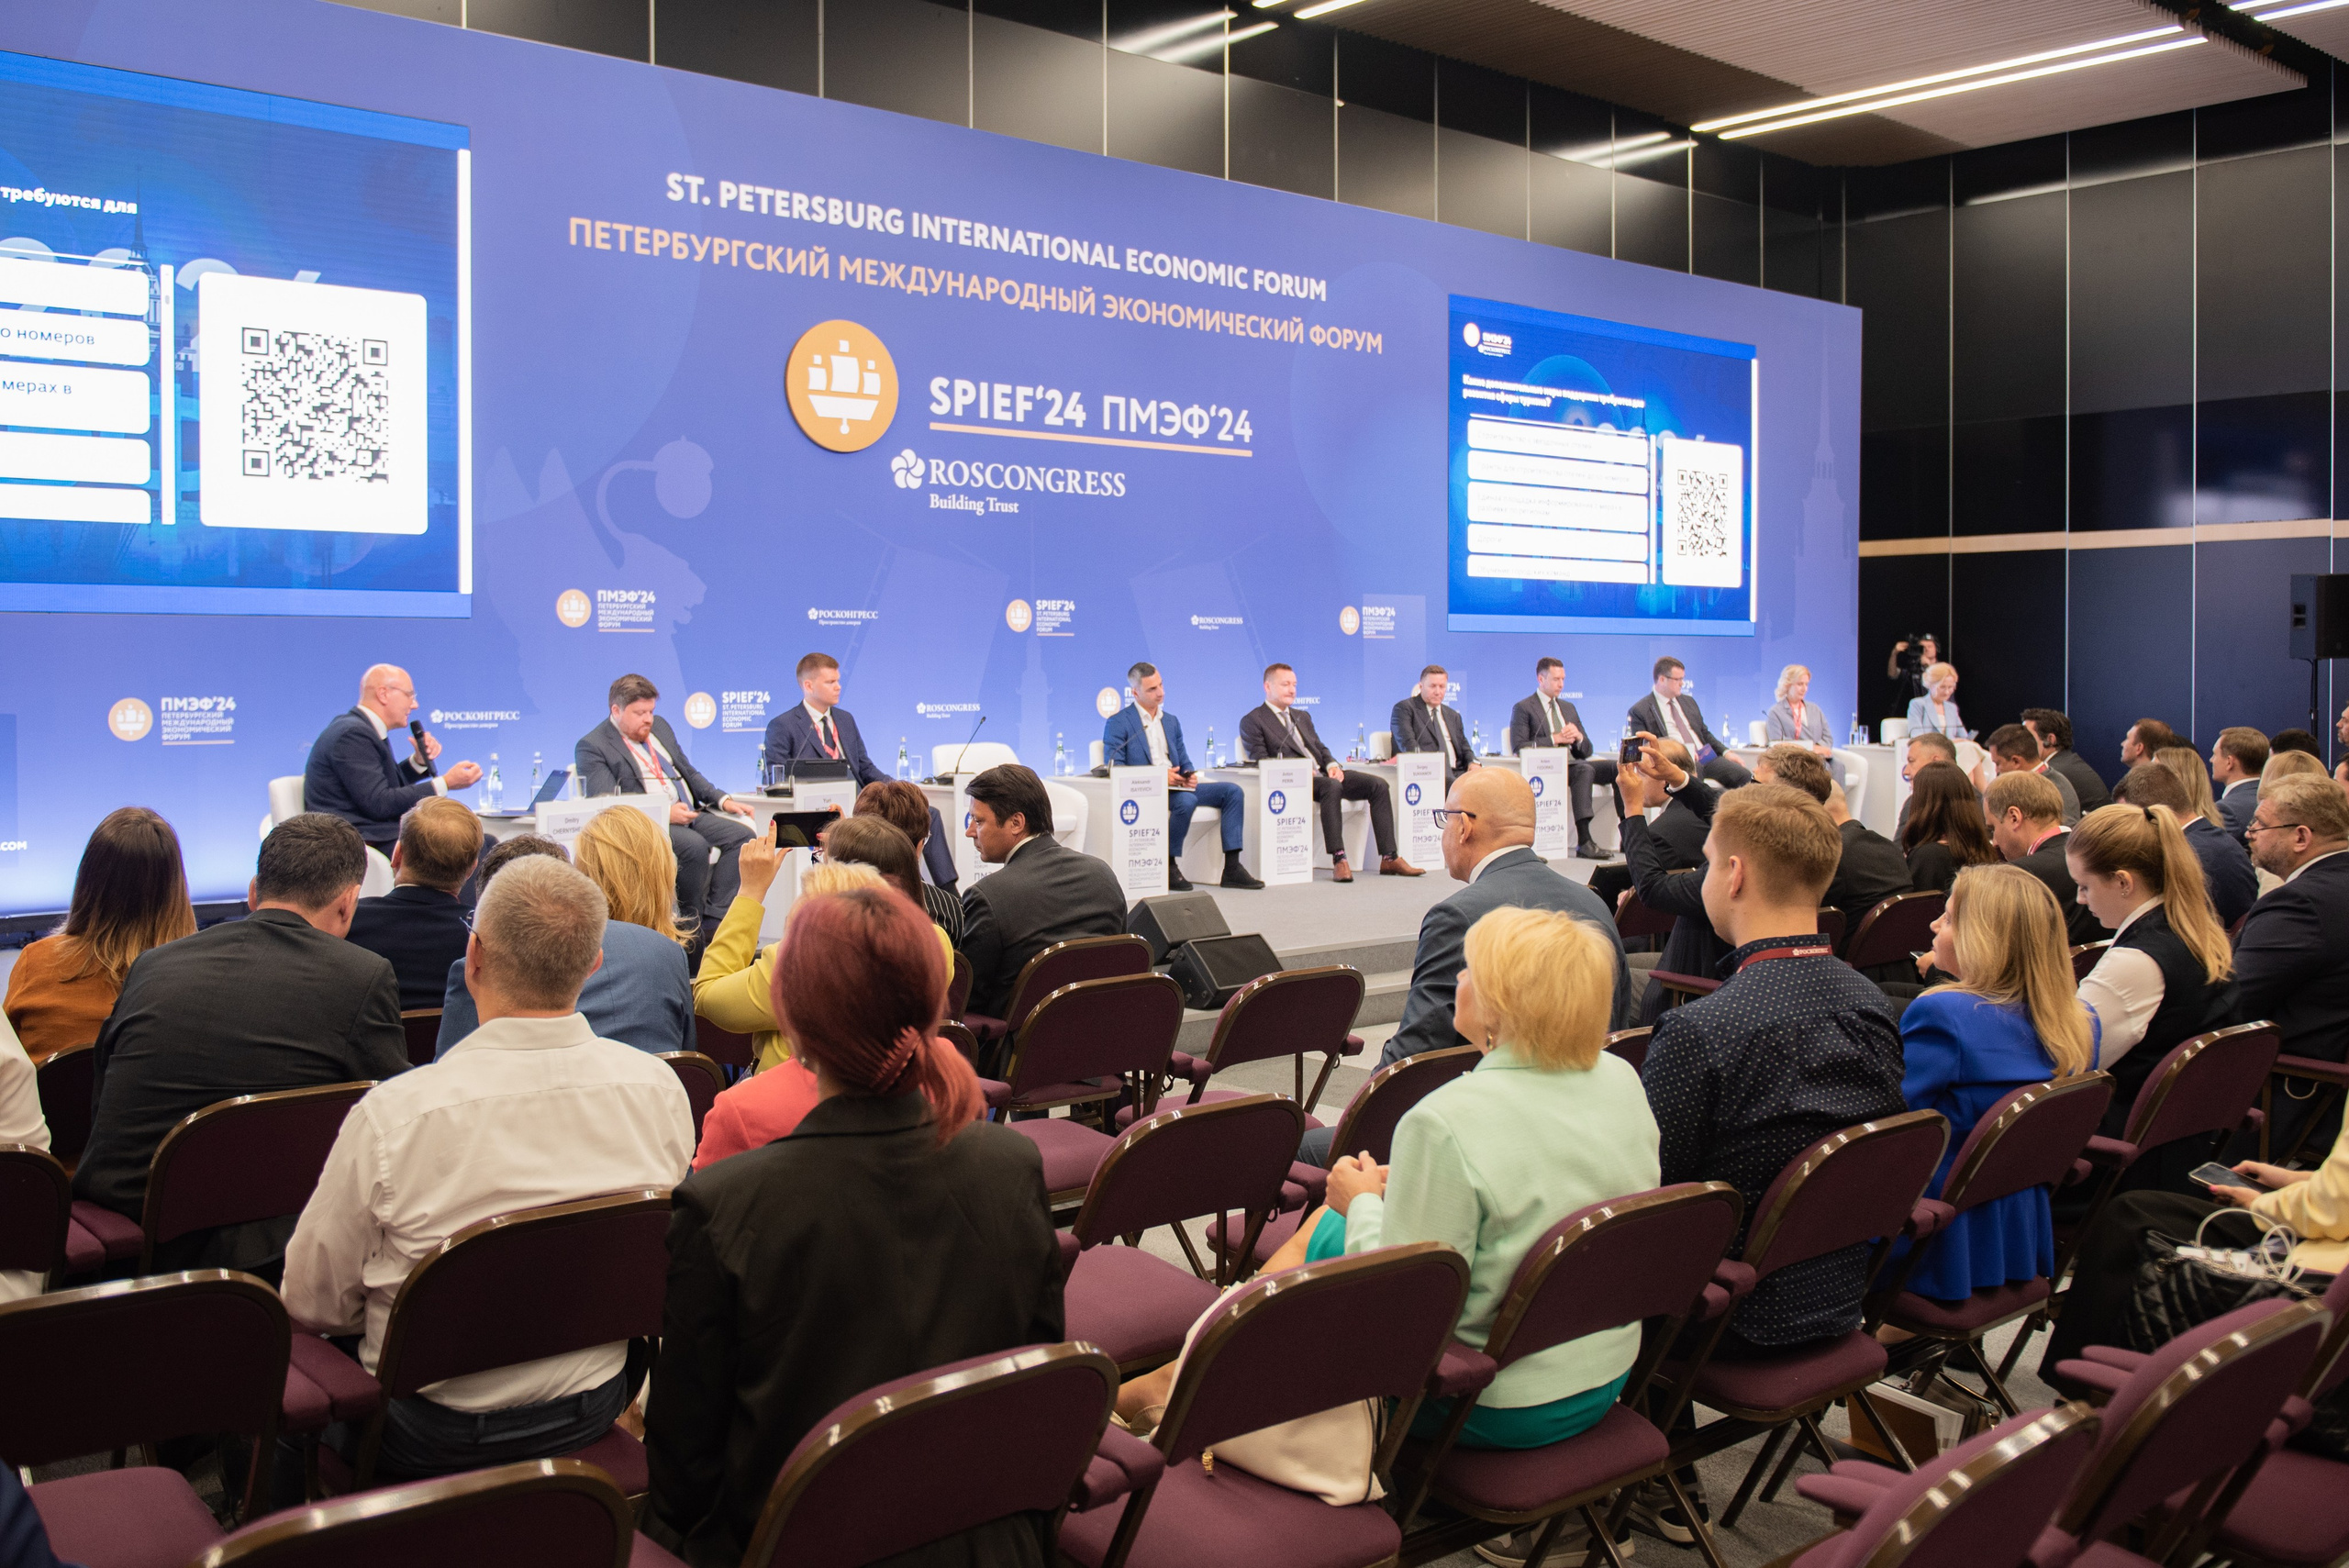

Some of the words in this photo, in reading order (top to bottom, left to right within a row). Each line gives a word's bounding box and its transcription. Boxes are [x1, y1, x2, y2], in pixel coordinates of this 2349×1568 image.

[0, 185, 102, 210] требуются
[103, 198, 138, 215] для
[666, 172, 711, 206] ST.
[719, 180, 905, 235] PETERSBURG
[912, 211, 1121, 271] INTERNATIONAL
[1126, 248, 1248, 290] ECONOMIC
[1253, 269, 1327, 301] FORUM
[570, 217, 829, 279] ПЕТЕРБУРГСКИЙ
[839, 255, 1096, 316] МЕЖДУНАРОДНЫЙ
[1102, 294, 1304, 344] ЭКОНОМИЧЕСКИЙ
[1309, 324, 1383, 355] ФОРУМ
[17, 329, 95, 346] номеров
[2, 380, 58, 395] мерах
[63, 384, 72, 395] в
[929, 376, 1086, 428] SPIEF'24
[1102, 395, 1253, 443] ПМЭФ'24
[929, 458, 1127, 497] ROSCONGRESS
[929, 494, 985, 516] Building
[986, 496, 1019, 514] Trust
[597, 589, 656, 603] ПМЭФ'24
[1036, 599, 1075, 611] SPIEF'24
[1363, 606, 1396, 617] ПМЭФ'24
[818, 610, 878, 619] РОСКОНГРЕСС
[161, 696, 237, 711] ПМЭФ'24
[722, 691, 771, 704] SPIEF'24
[926, 703, 980, 713] ROSCONGRESS
[444, 710, 521, 721] РОСКОНГРЕСС
[1276, 817, 1306, 826] SPIEF'24
[552, 826, 582, 835] CHERNYSHE
[1129, 828, 1161, 838] SPIEF'24
[1276, 844, 1308, 854] ПМЭФ'24
[1129, 858, 1163, 867] ПМЭФ'24
